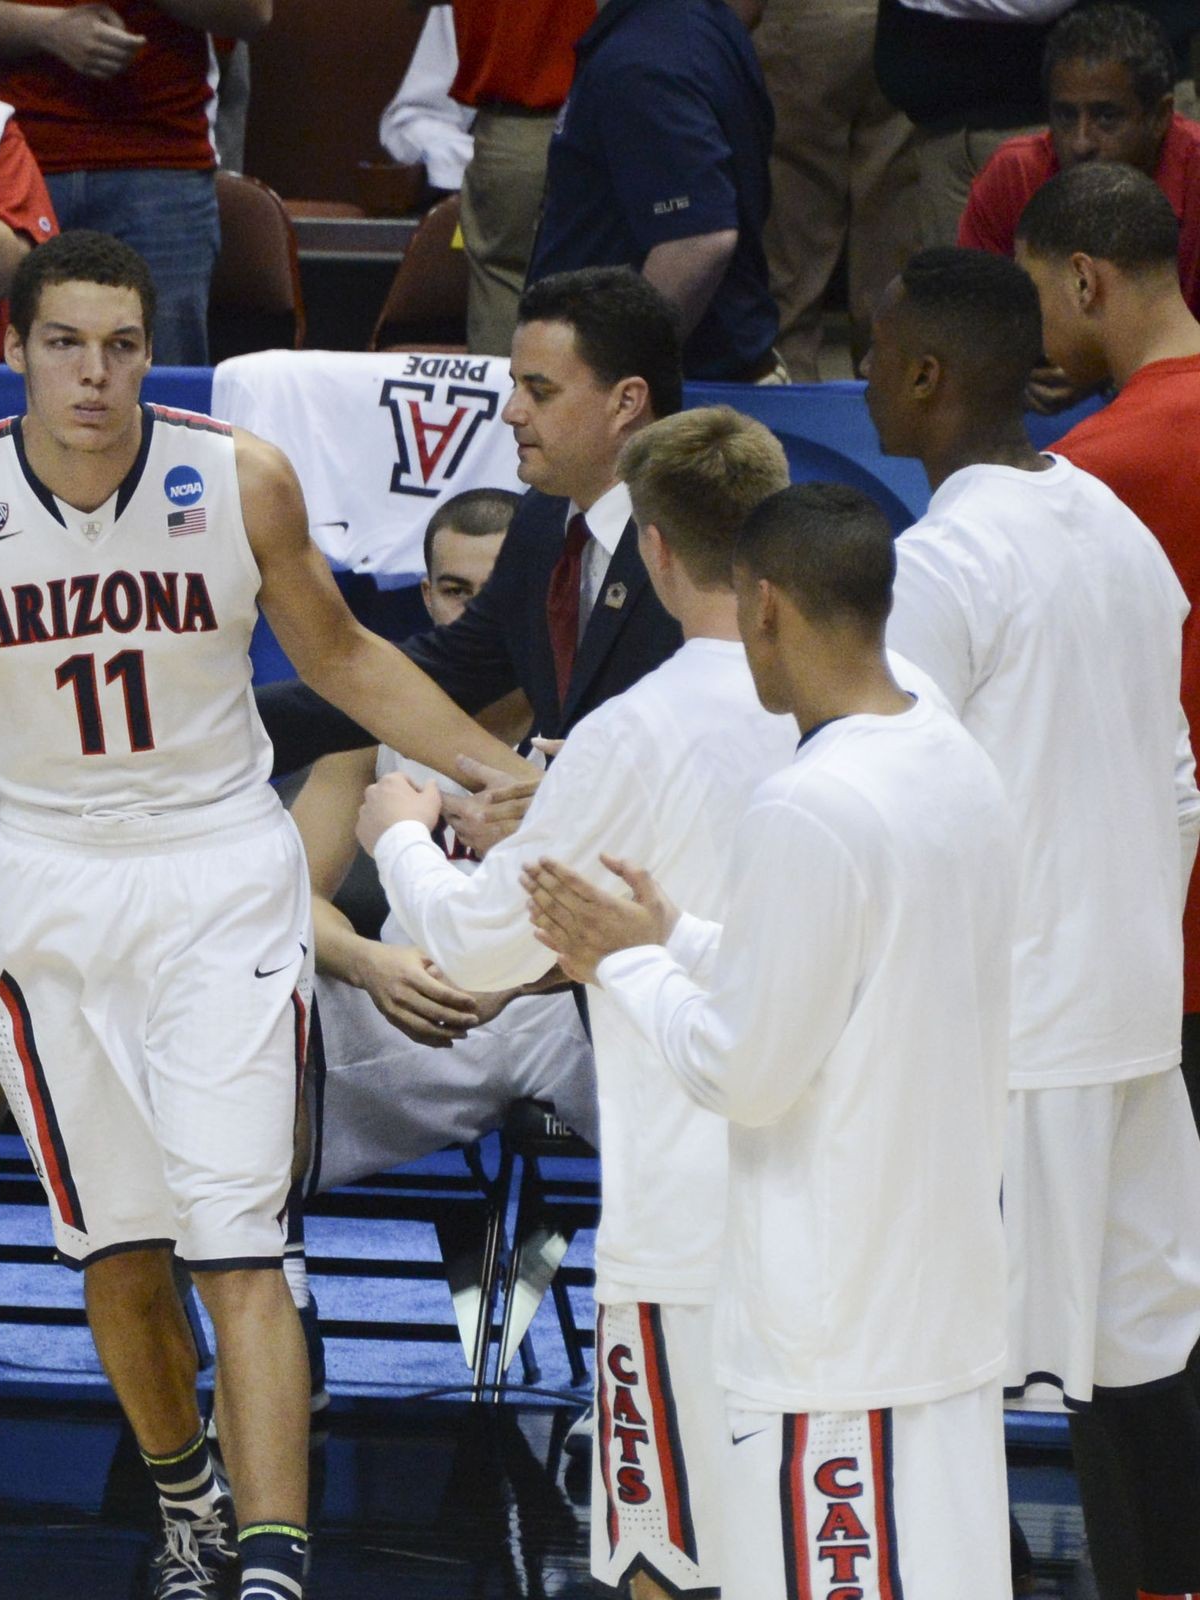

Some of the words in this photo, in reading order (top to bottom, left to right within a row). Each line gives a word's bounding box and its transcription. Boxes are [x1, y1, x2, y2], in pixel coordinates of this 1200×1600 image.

[403, 356, 490, 383] PRIDE
[170, 482, 202, 498] NCAA
[54, 649, 156, 755] 11
[607, 1344, 652, 1505] CATS
